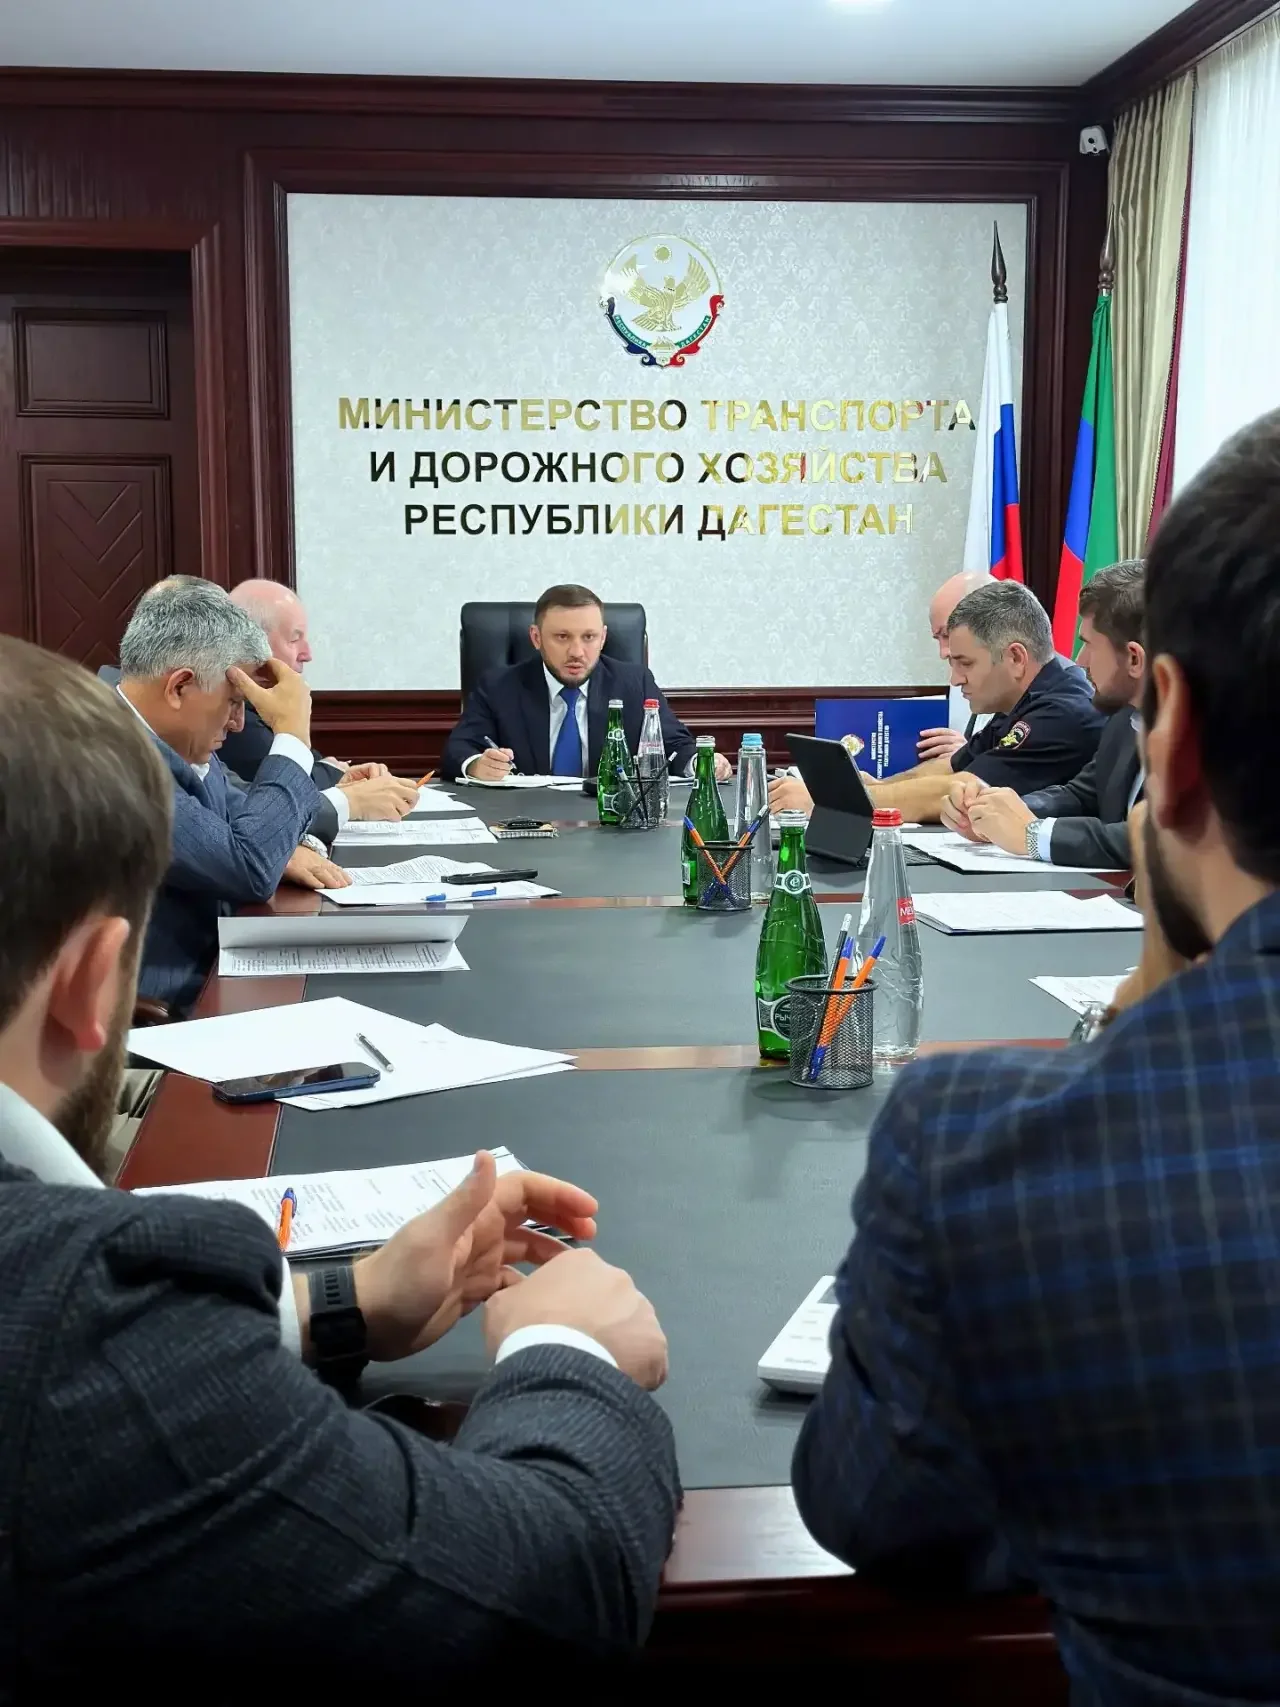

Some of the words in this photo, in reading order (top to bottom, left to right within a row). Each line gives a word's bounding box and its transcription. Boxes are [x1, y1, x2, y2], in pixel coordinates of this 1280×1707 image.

[338, 397, 687, 431] МИНИСТЕРСТВО
[701, 399, 976, 431] ТРАНСПОРТА
[370, 451, 395, 482] И
[409, 451, 685, 488] ДОРОЖНОГО
[698, 445, 948, 484] ХОЗЯЙСТВА
[404, 503, 683, 535] РЕСПУБЛИКИ
[697, 503, 913, 541] ДАГЕСТАН
